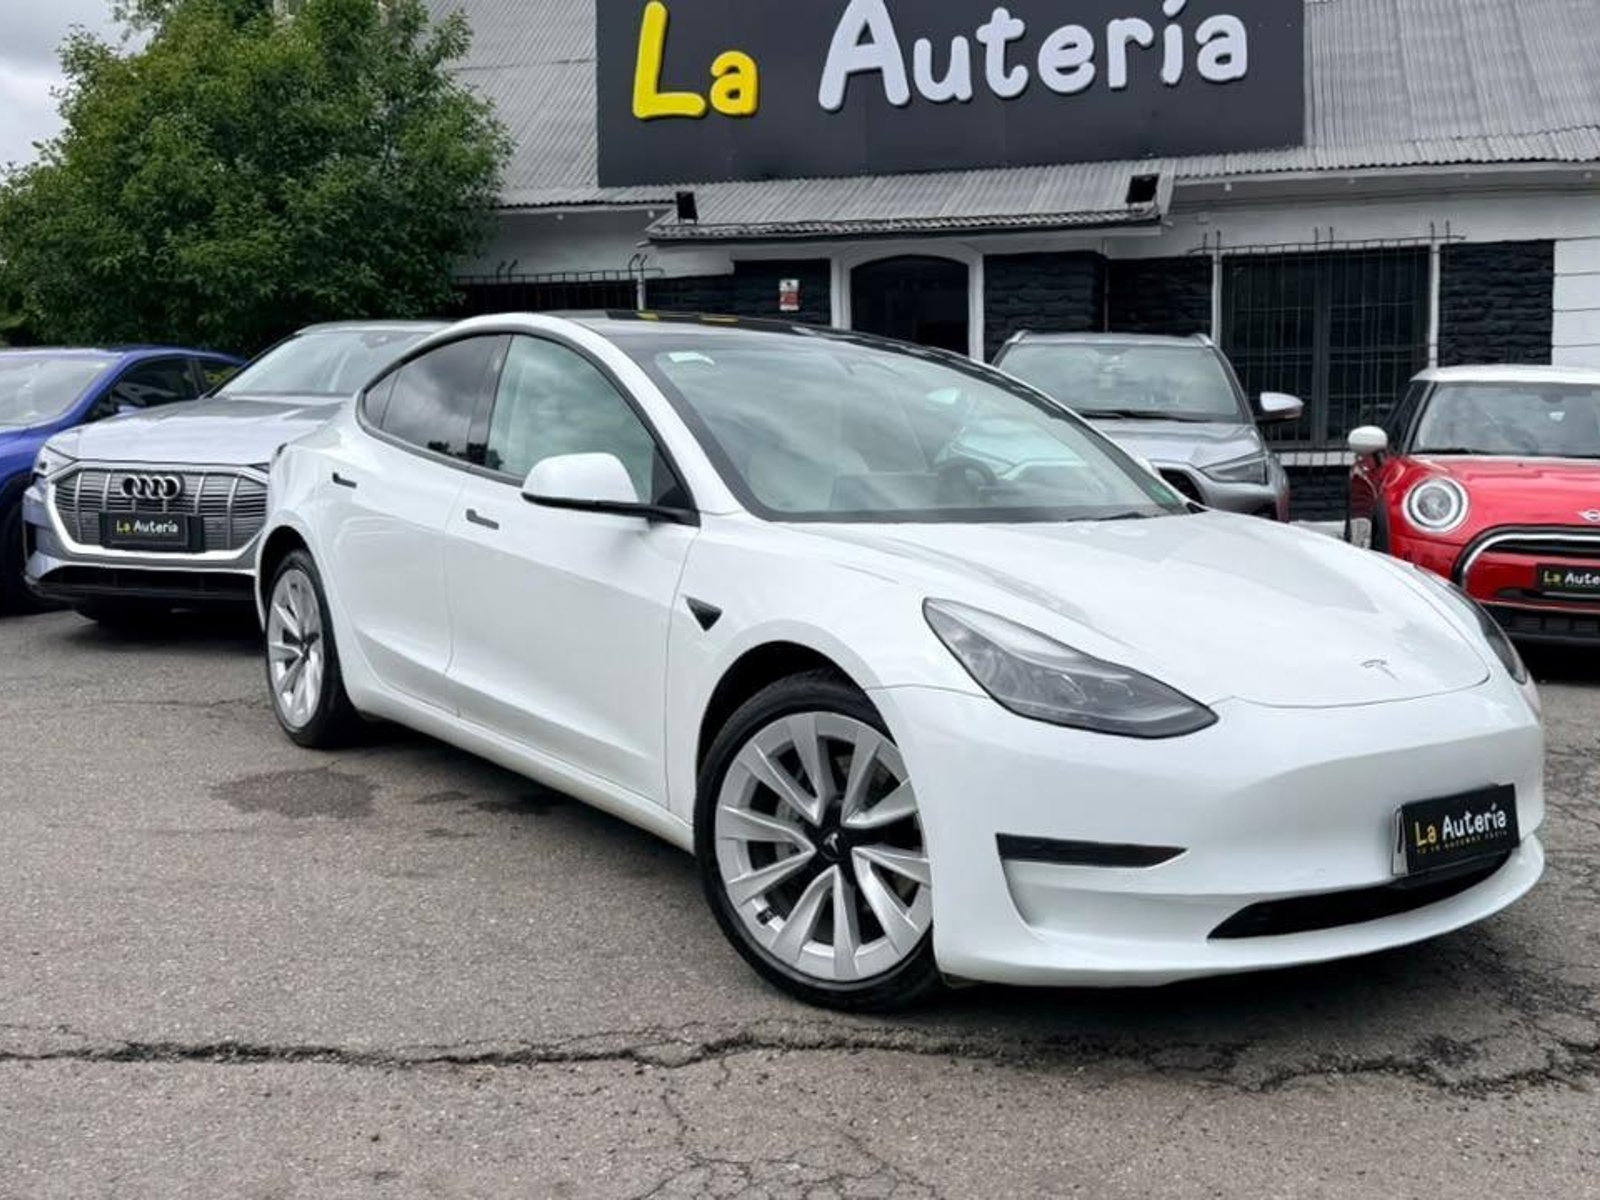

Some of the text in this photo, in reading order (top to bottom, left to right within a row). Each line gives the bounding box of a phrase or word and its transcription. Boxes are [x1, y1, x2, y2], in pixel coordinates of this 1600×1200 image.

[632, 0, 1248, 118] La Autería
[116, 521, 130, 532] La
[1544, 570, 1561, 583] La
[1415, 821, 1437, 846] La
[1442, 803, 1506, 841] Autería
